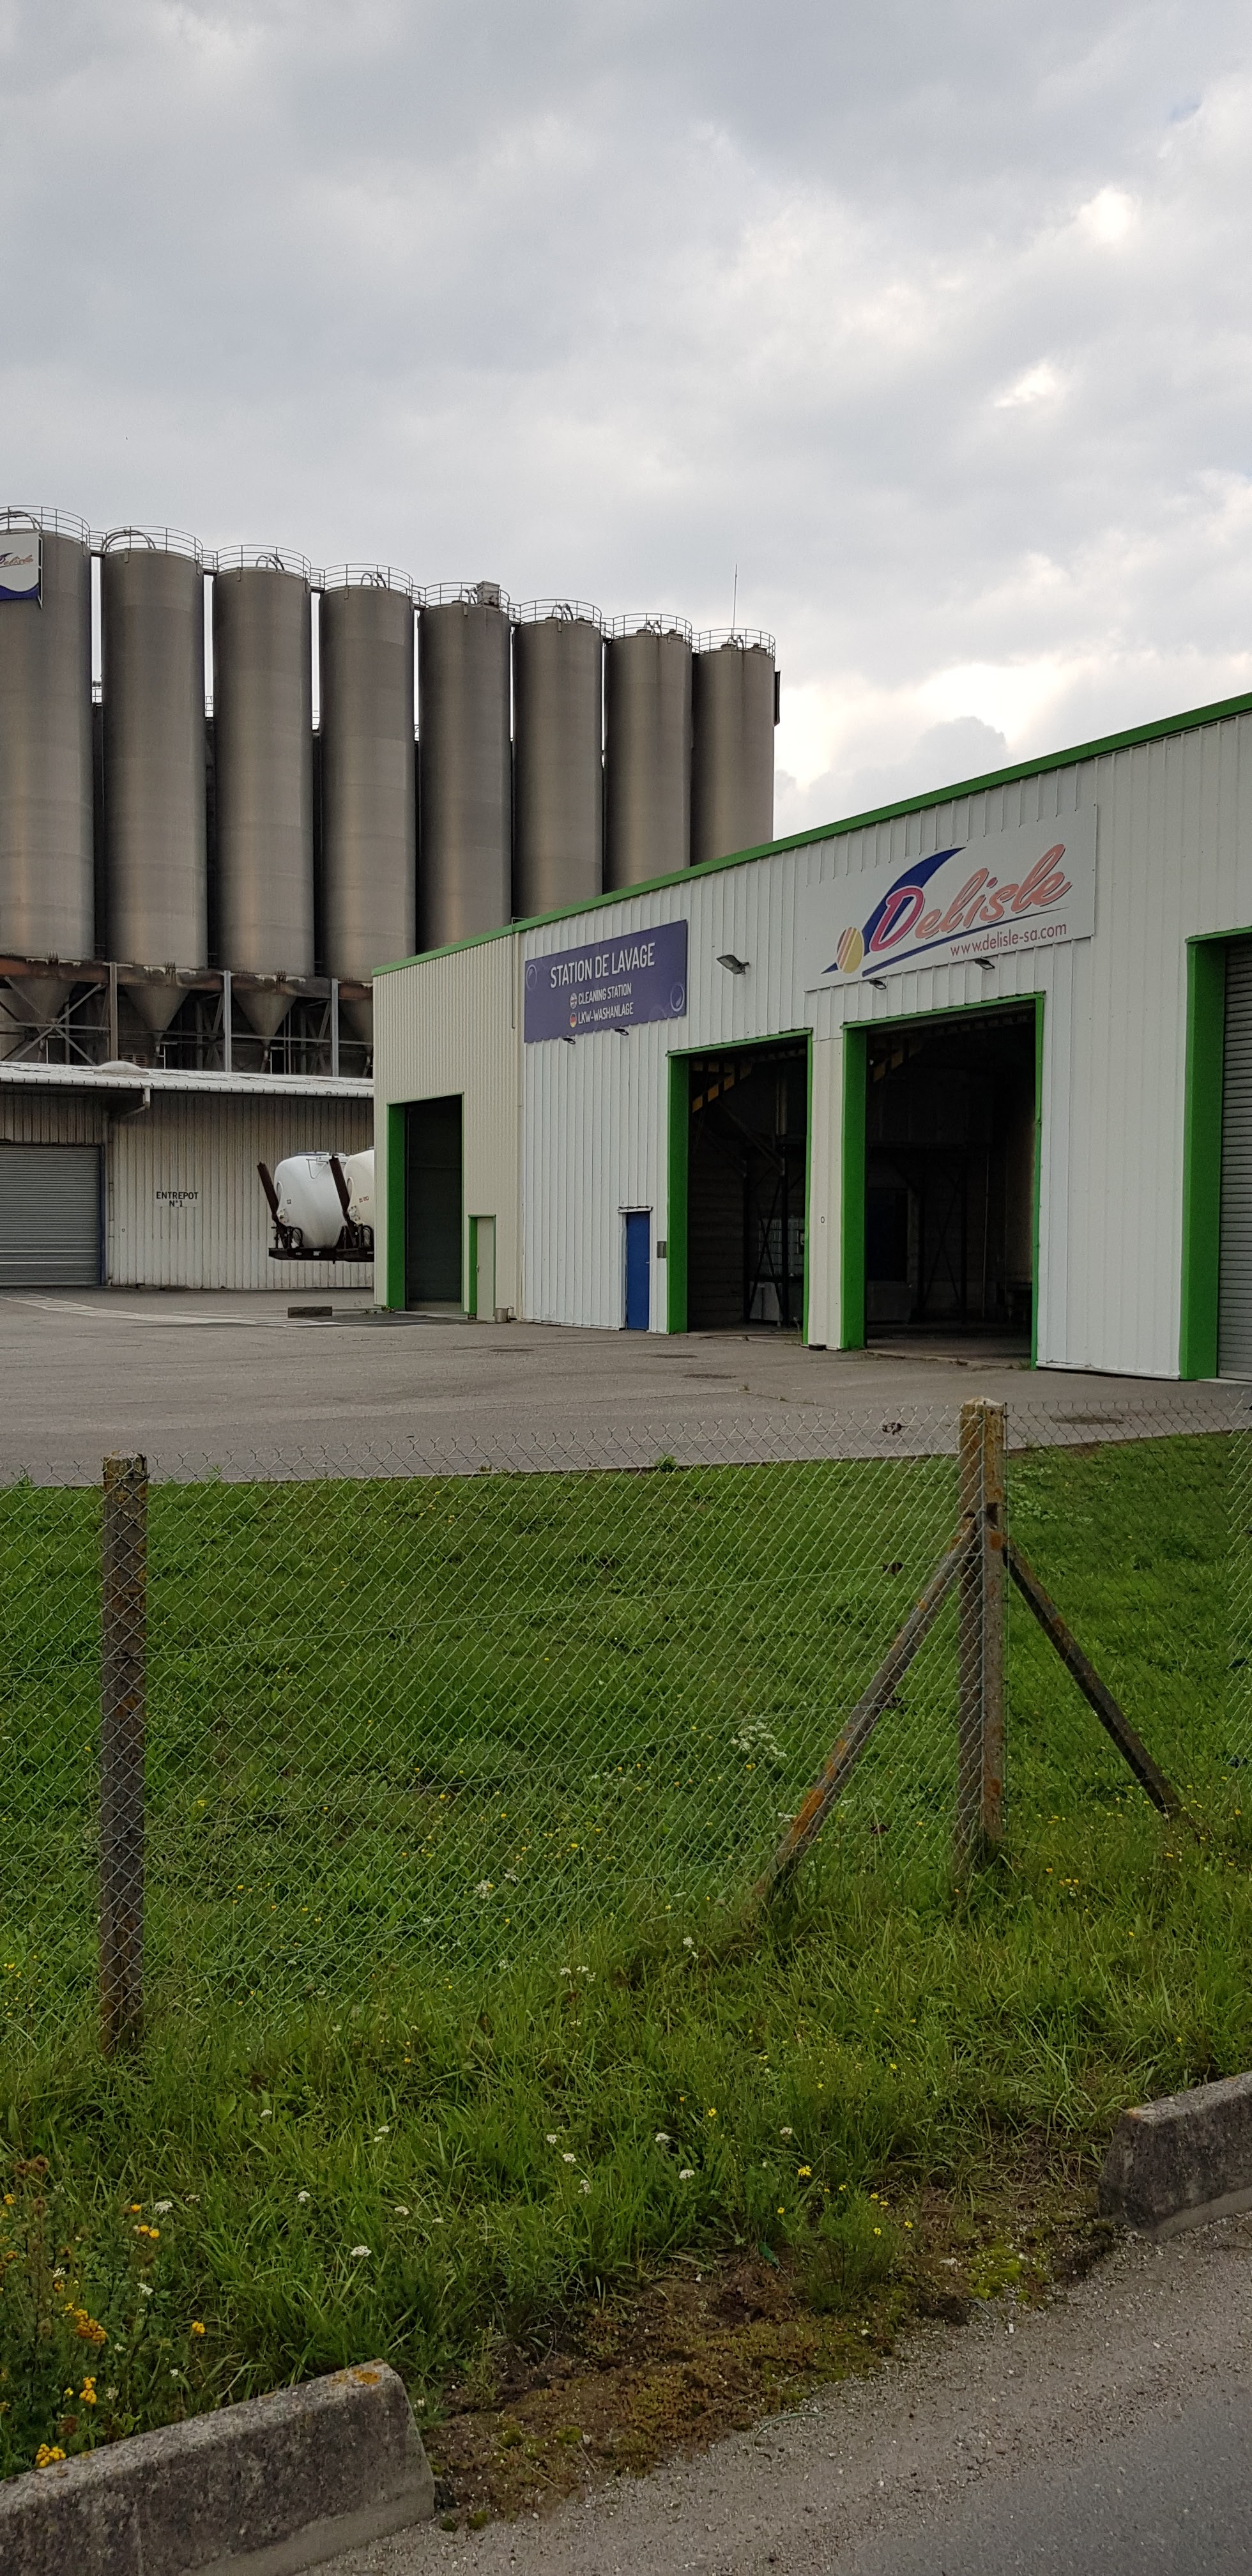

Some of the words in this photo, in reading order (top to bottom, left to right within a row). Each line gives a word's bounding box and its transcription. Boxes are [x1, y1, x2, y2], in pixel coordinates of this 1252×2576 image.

[869, 843, 1073, 952] Delisle
[950, 923, 1067, 957] www.delisle-sa.com
[550, 958, 593, 988] STATION
[595, 954, 609, 979] DE
[611, 942, 655, 974] LAVAGE
[578, 988, 606, 1005] CLEANING
[607, 983, 632, 999] STATION
[578, 1002, 634, 1024] LKW-WASHANLAGE
[156, 1191, 199, 1199] ENTREPOT
